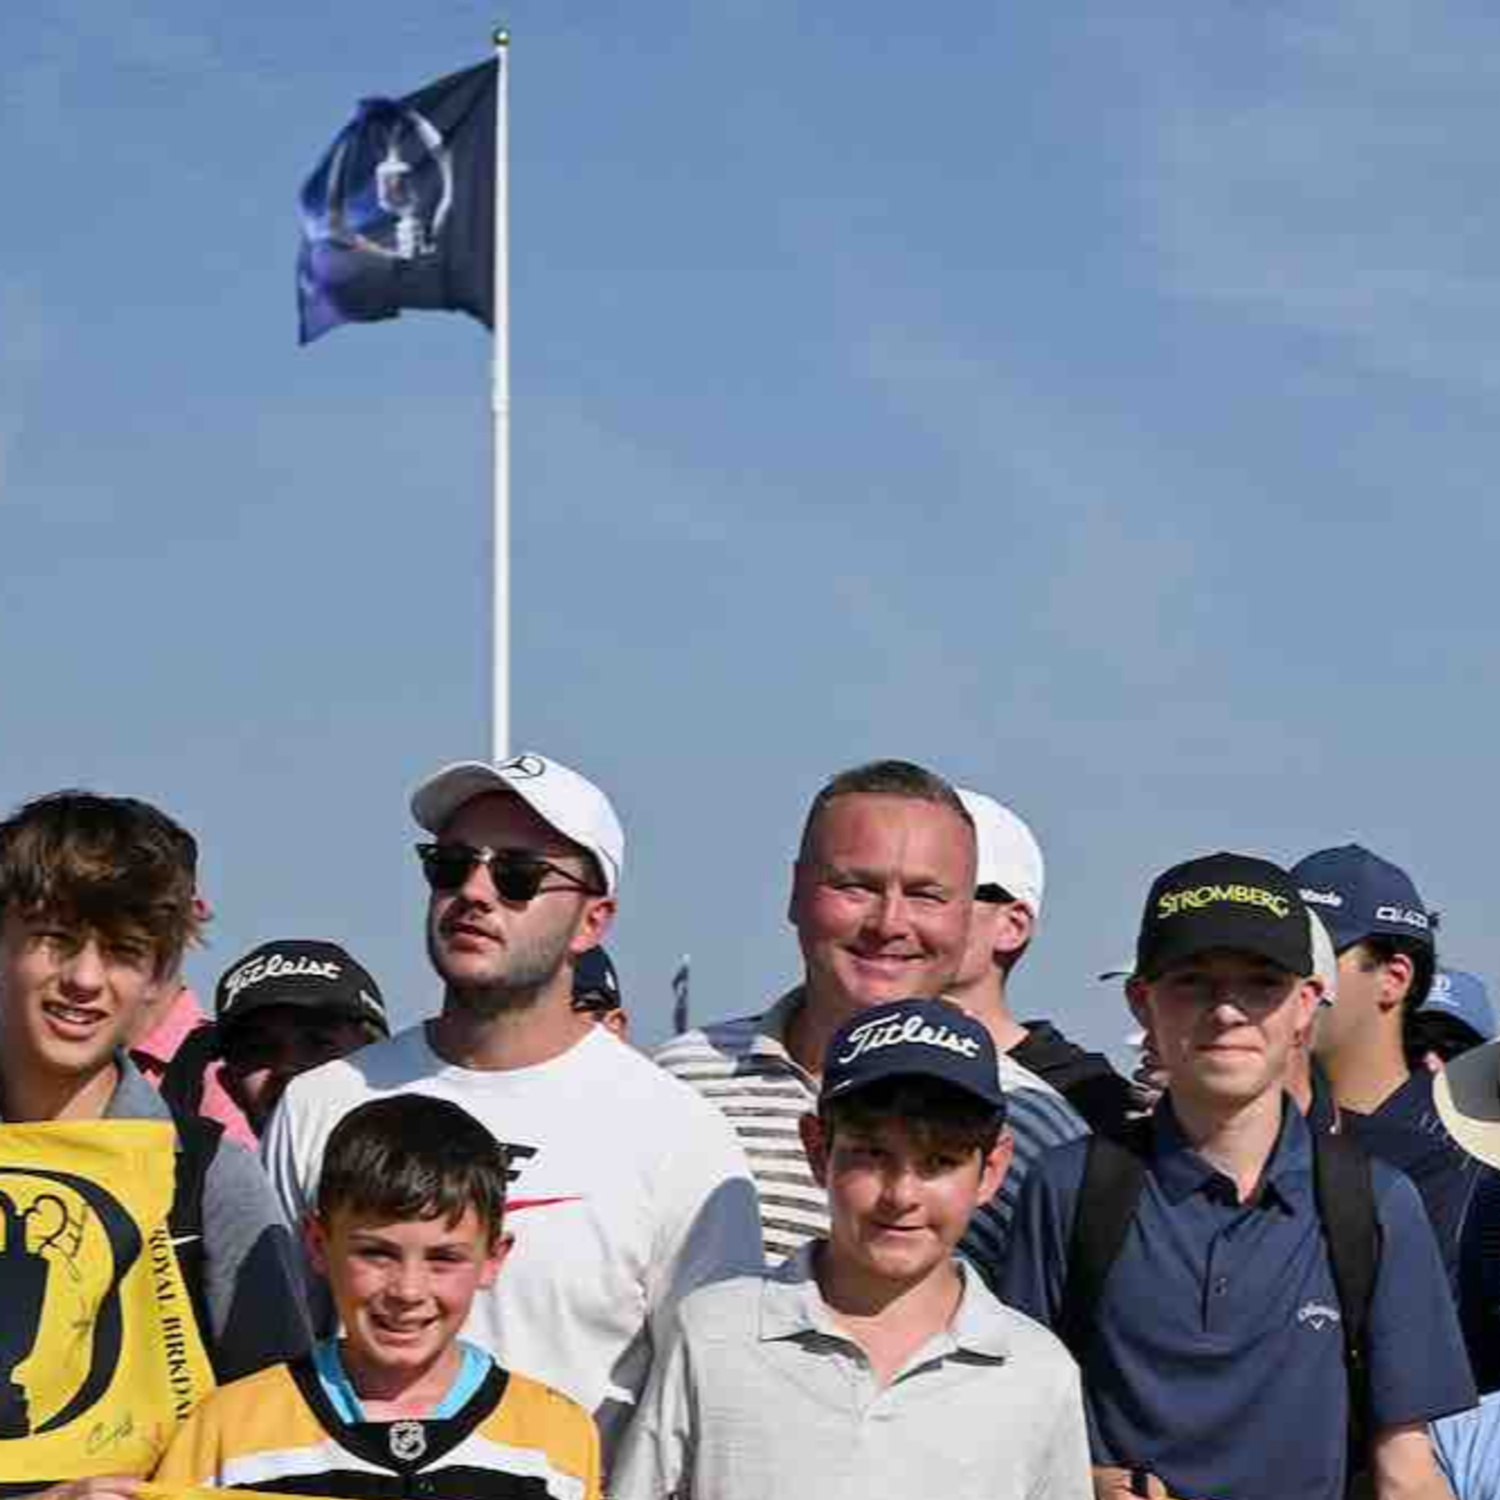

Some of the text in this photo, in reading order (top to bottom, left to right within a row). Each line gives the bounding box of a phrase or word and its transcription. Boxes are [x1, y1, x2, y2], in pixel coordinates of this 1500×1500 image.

[1157, 883, 1290, 919] STROMBERG
[223, 953, 343, 1012] Titleist
[838, 1012, 981, 1063] Titleist
[149, 1223, 178, 1308] ROYAL
